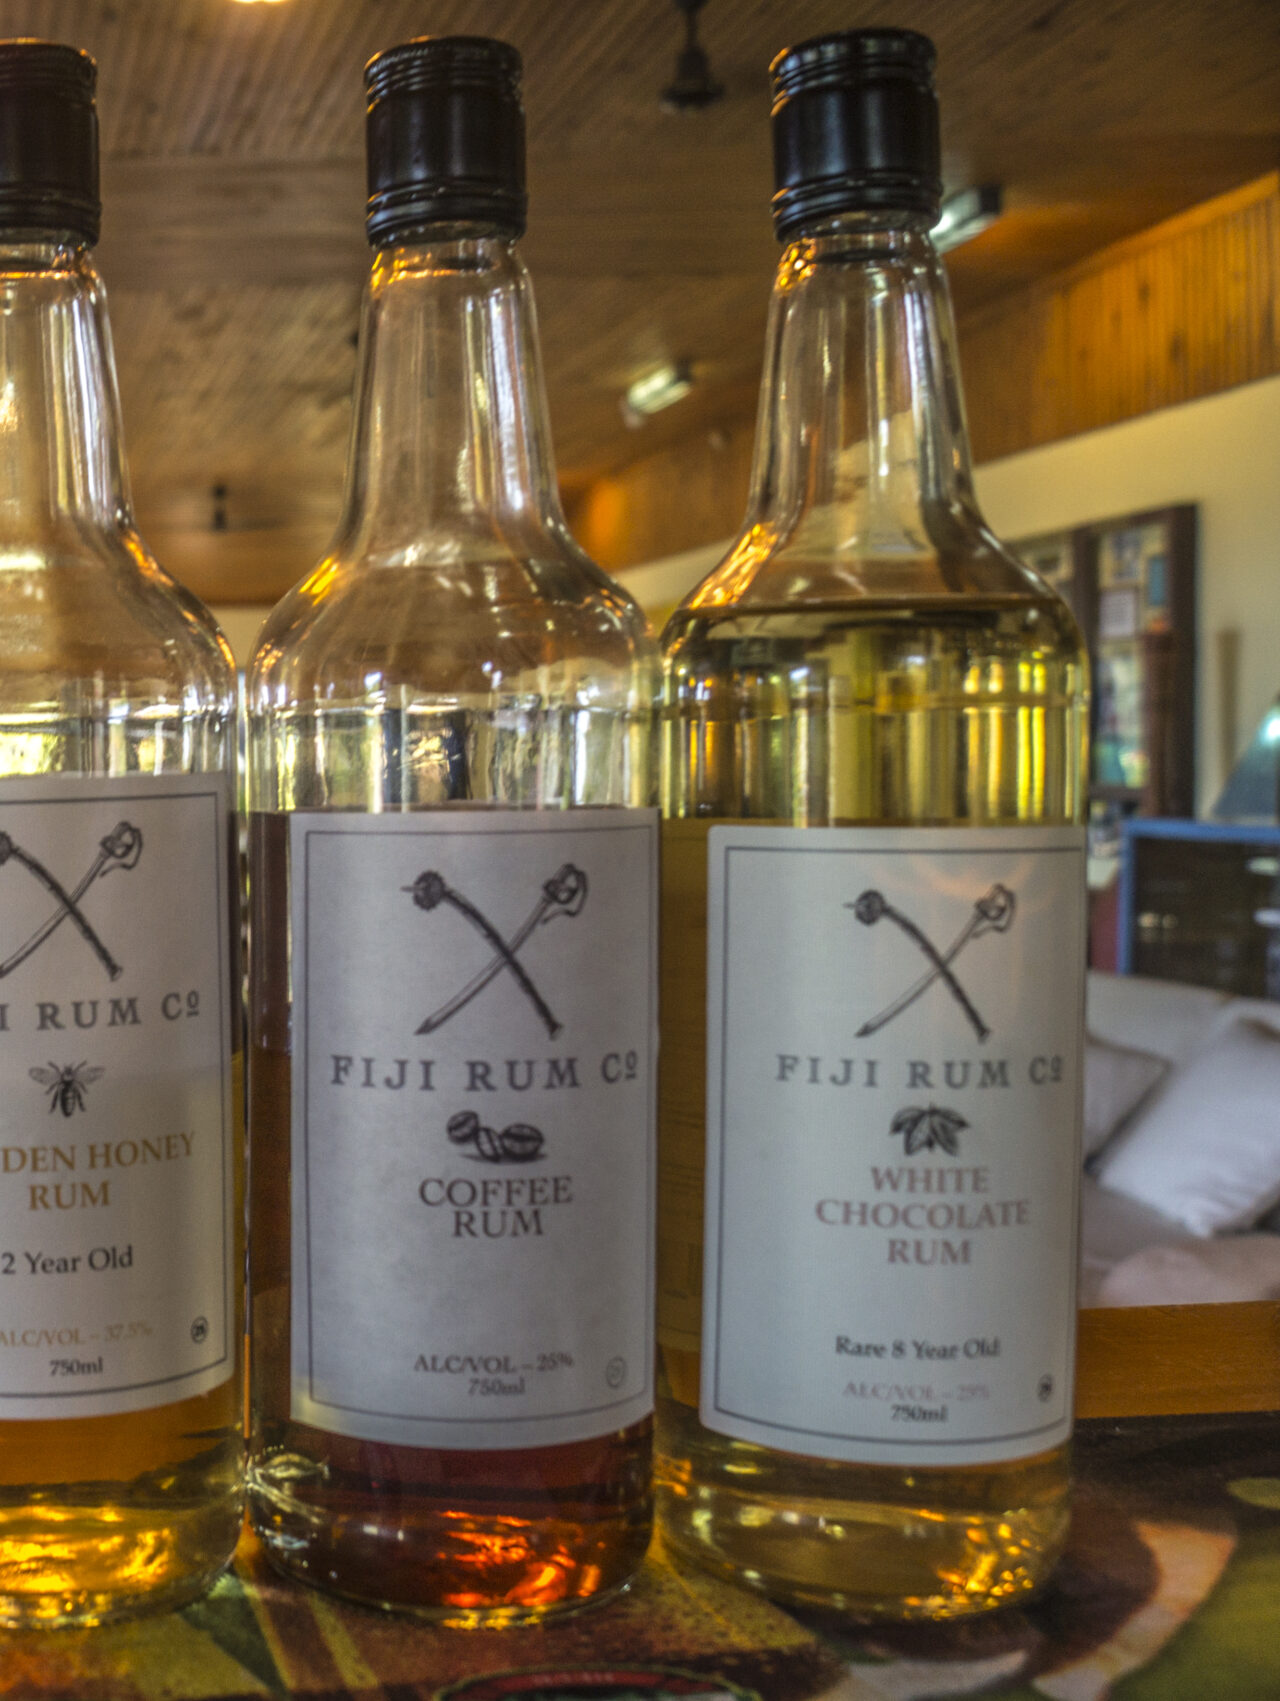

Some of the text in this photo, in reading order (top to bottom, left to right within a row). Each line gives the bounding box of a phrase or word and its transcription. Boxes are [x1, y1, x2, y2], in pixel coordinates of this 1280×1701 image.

[36, 997, 142, 1030] RUM
[330, 1054, 436, 1091] FIJI
[466, 1057, 580, 1092] RUM
[775, 1054, 880, 1088] FIJI
[907, 1059, 1011, 1090] RUM
[89, 1131, 196, 1169] HONEY
[419, 1176, 573, 1207] COFFEE
[871, 1166, 990, 1194] WHITE
[28, 1181, 111, 1211] RUM
[452, 1208, 545, 1238] RUM
[815, 1197, 1030, 1231] CHOCOLATE
[1, 1245, 134, 1275] 2 Year Old
[887, 1239, 973, 1266] RUM
[835, 1335, 1001, 1360] Rare 8 Year Old
[49, 1356, 104, 1376] 750ml
[468, 1375, 525, 1397] 750ml
[890, 1404, 948, 1423] 750ml
